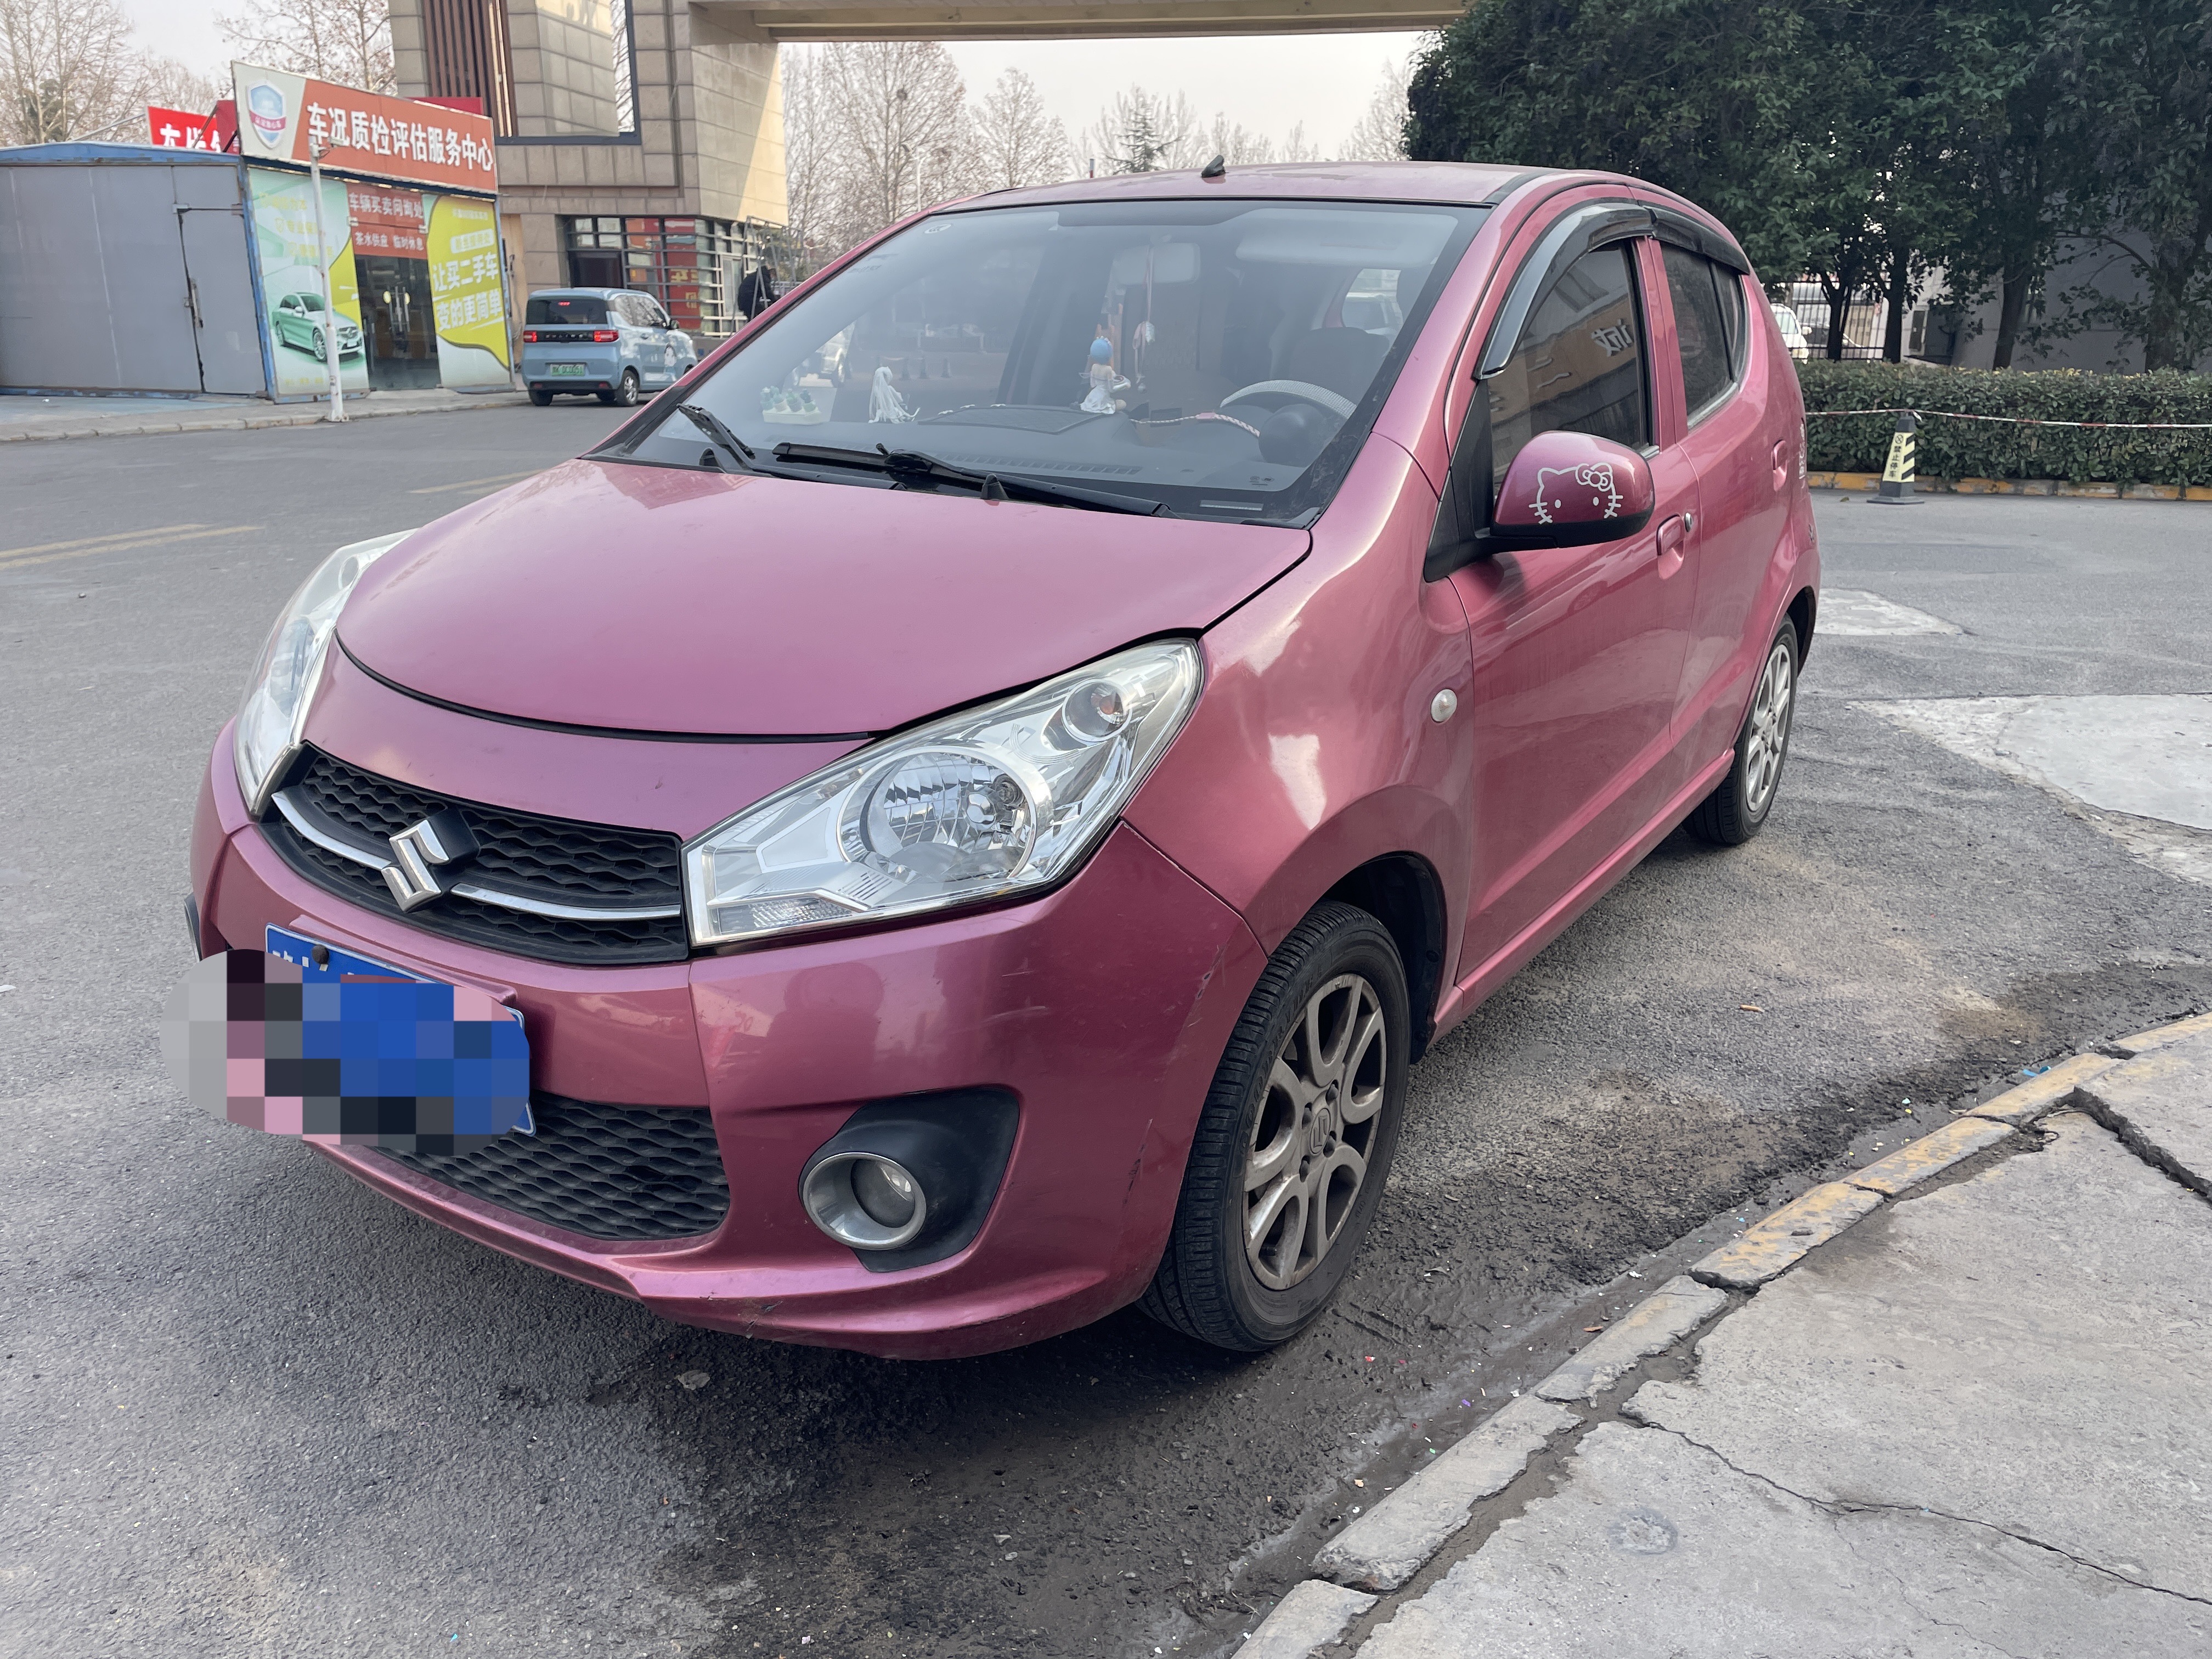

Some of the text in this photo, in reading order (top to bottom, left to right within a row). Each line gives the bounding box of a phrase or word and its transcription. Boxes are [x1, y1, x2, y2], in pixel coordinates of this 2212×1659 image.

[306, 101, 493, 172] 车况质检评估服务中心
[432, 251, 499, 292] 让买二手车
[436, 288, 503, 332] 变的更简单
[1889, 445, 1901, 478] 禁止停车
